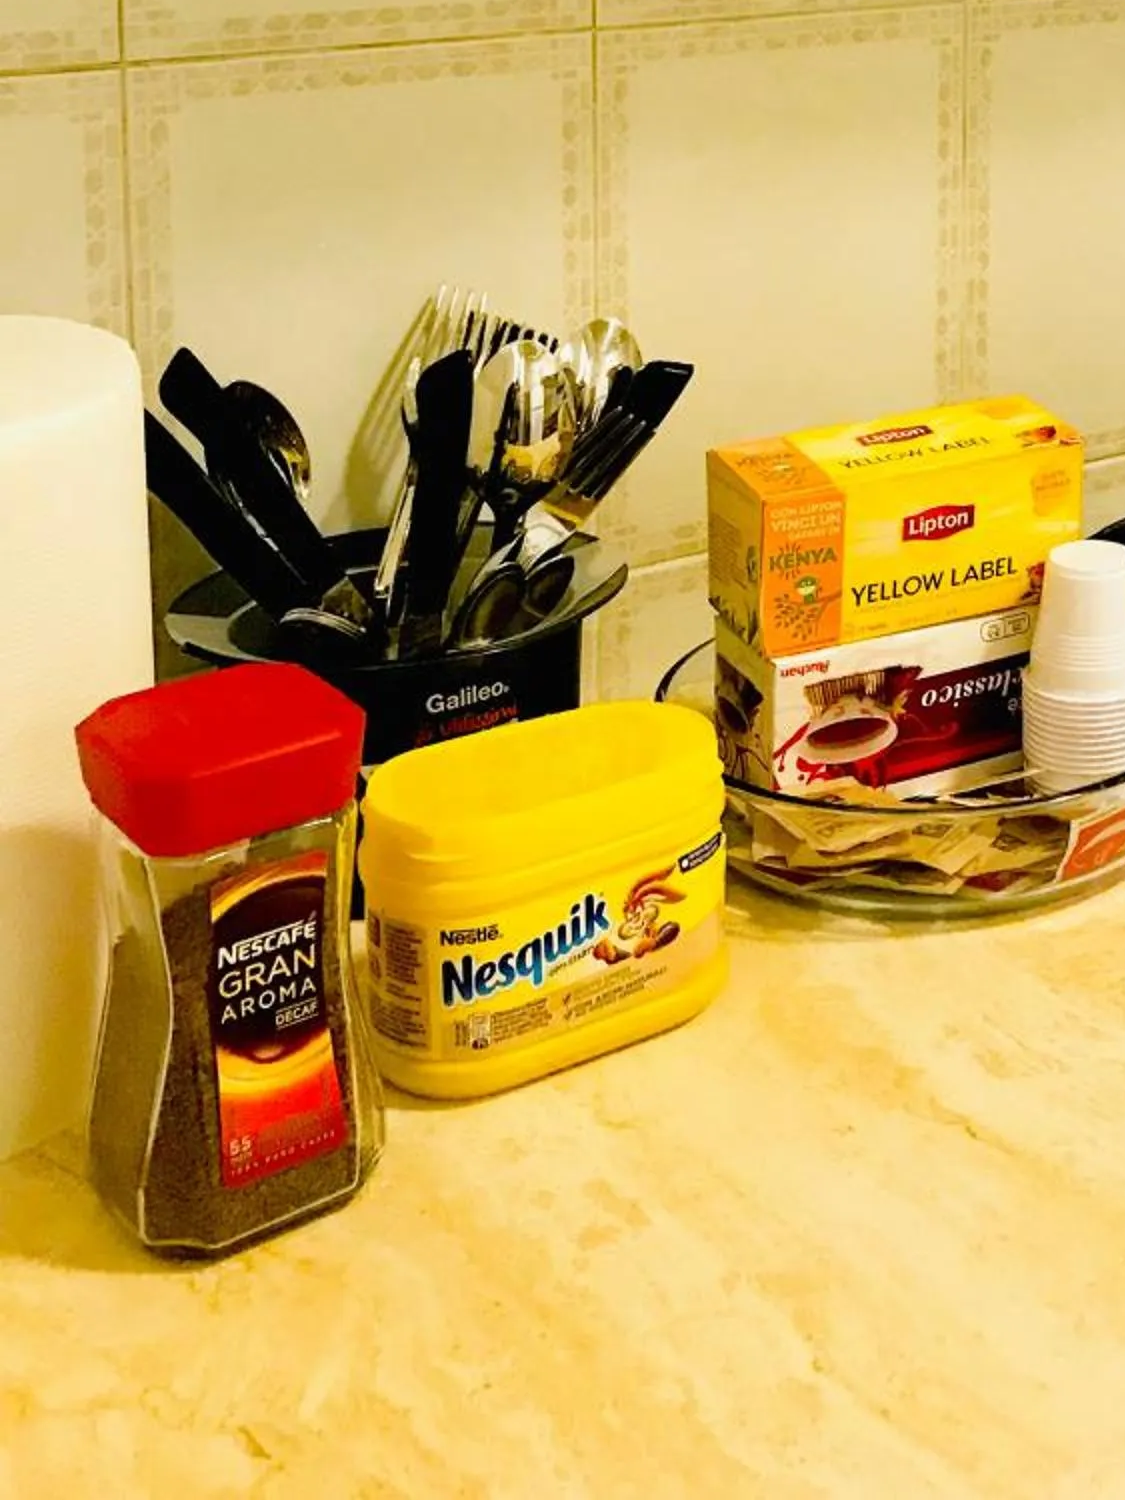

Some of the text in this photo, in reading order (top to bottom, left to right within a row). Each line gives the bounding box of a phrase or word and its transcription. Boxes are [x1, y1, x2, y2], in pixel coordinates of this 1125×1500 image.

[908, 510, 970, 536] Lipton
[768, 546, 837, 572] KENYA
[851, 555, 1018, 608] YELLOW LABEL
[780, 659, 830, 677] Auchan
[425, 681, 504, 714] Galileo
[217, 910, 317, 970] NESCAFÉ
[440, 893, 610, 1008] Nesquik
[219, 943, 316, 998] GRAN
[221, 976, 317, 1025] AROMA
[275, 1001, 318, 1026] DECAF
